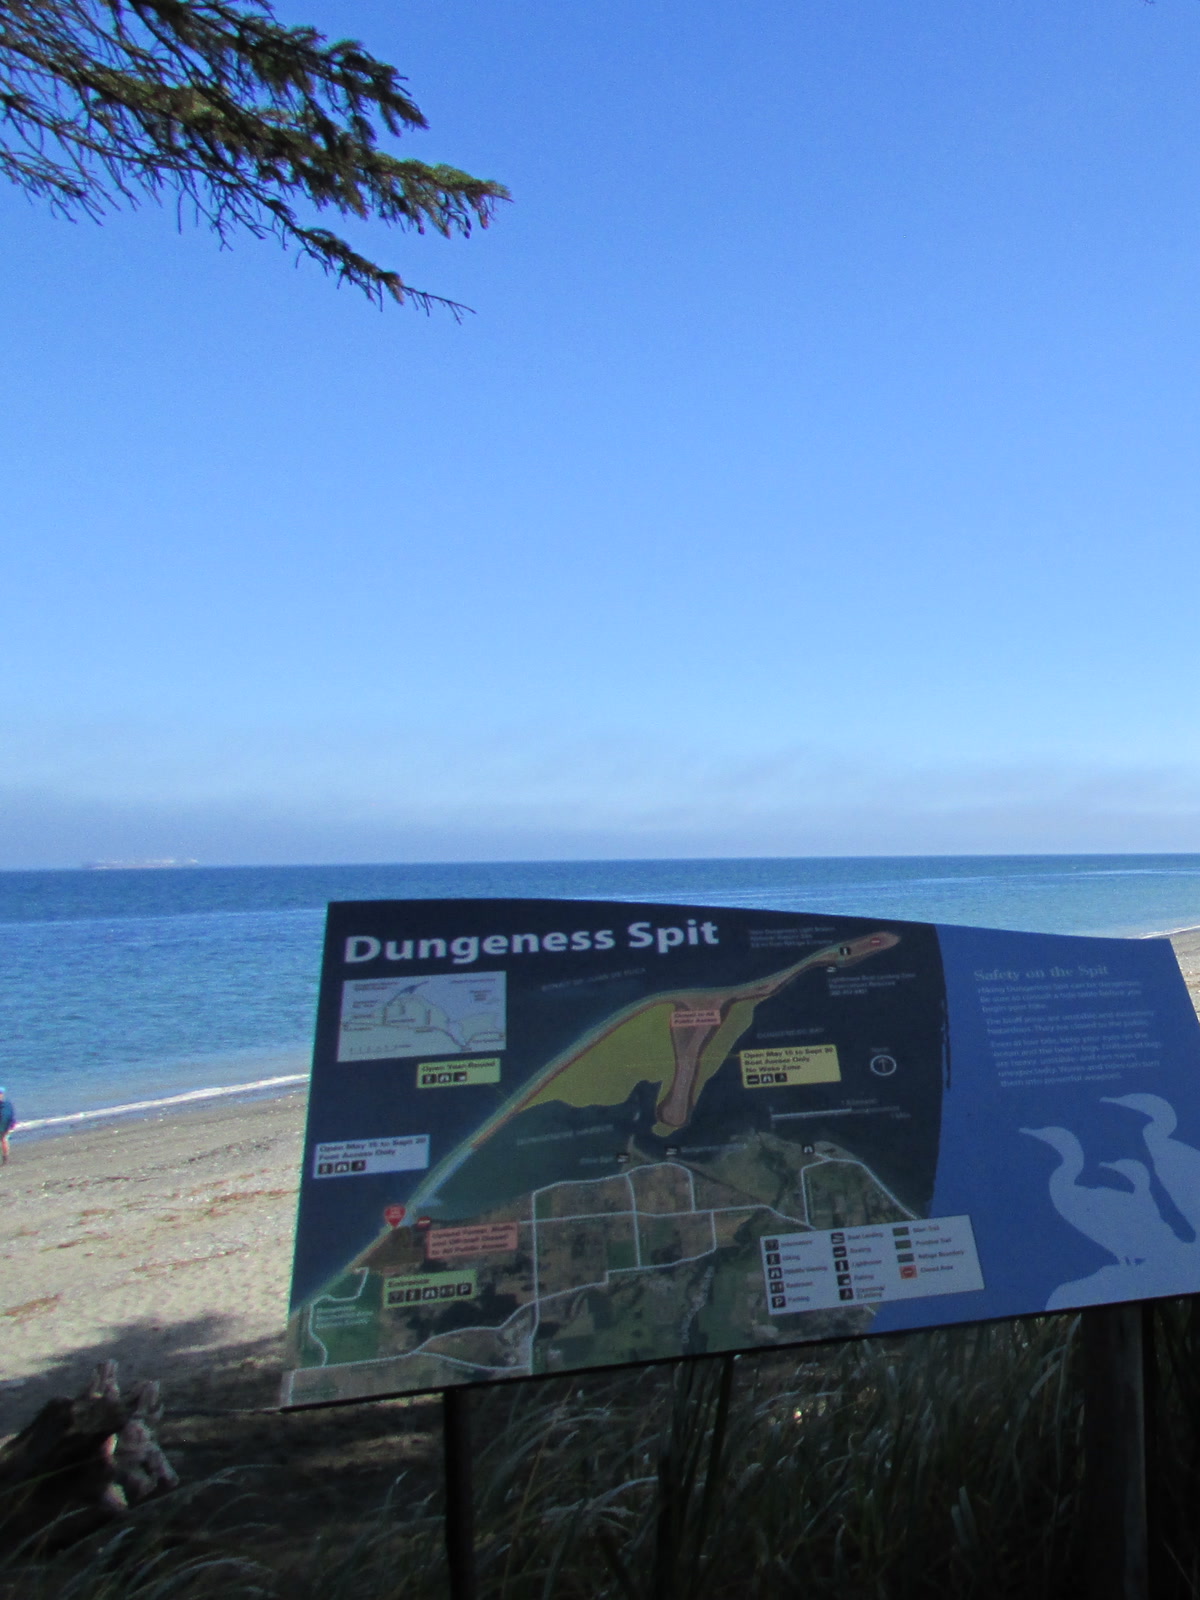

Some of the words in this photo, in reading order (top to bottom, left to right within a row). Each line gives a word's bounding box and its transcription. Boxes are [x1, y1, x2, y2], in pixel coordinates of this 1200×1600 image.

[344, 929, 615, 964] Dungeness
[628, 919, 719, 953] Spit
[974, 968, 1019, 981] Safety
[1025, 969, 1045, 979] on
[1050, 966, 1073, 978] the
[1078, 965, 1109, 979] Spit
